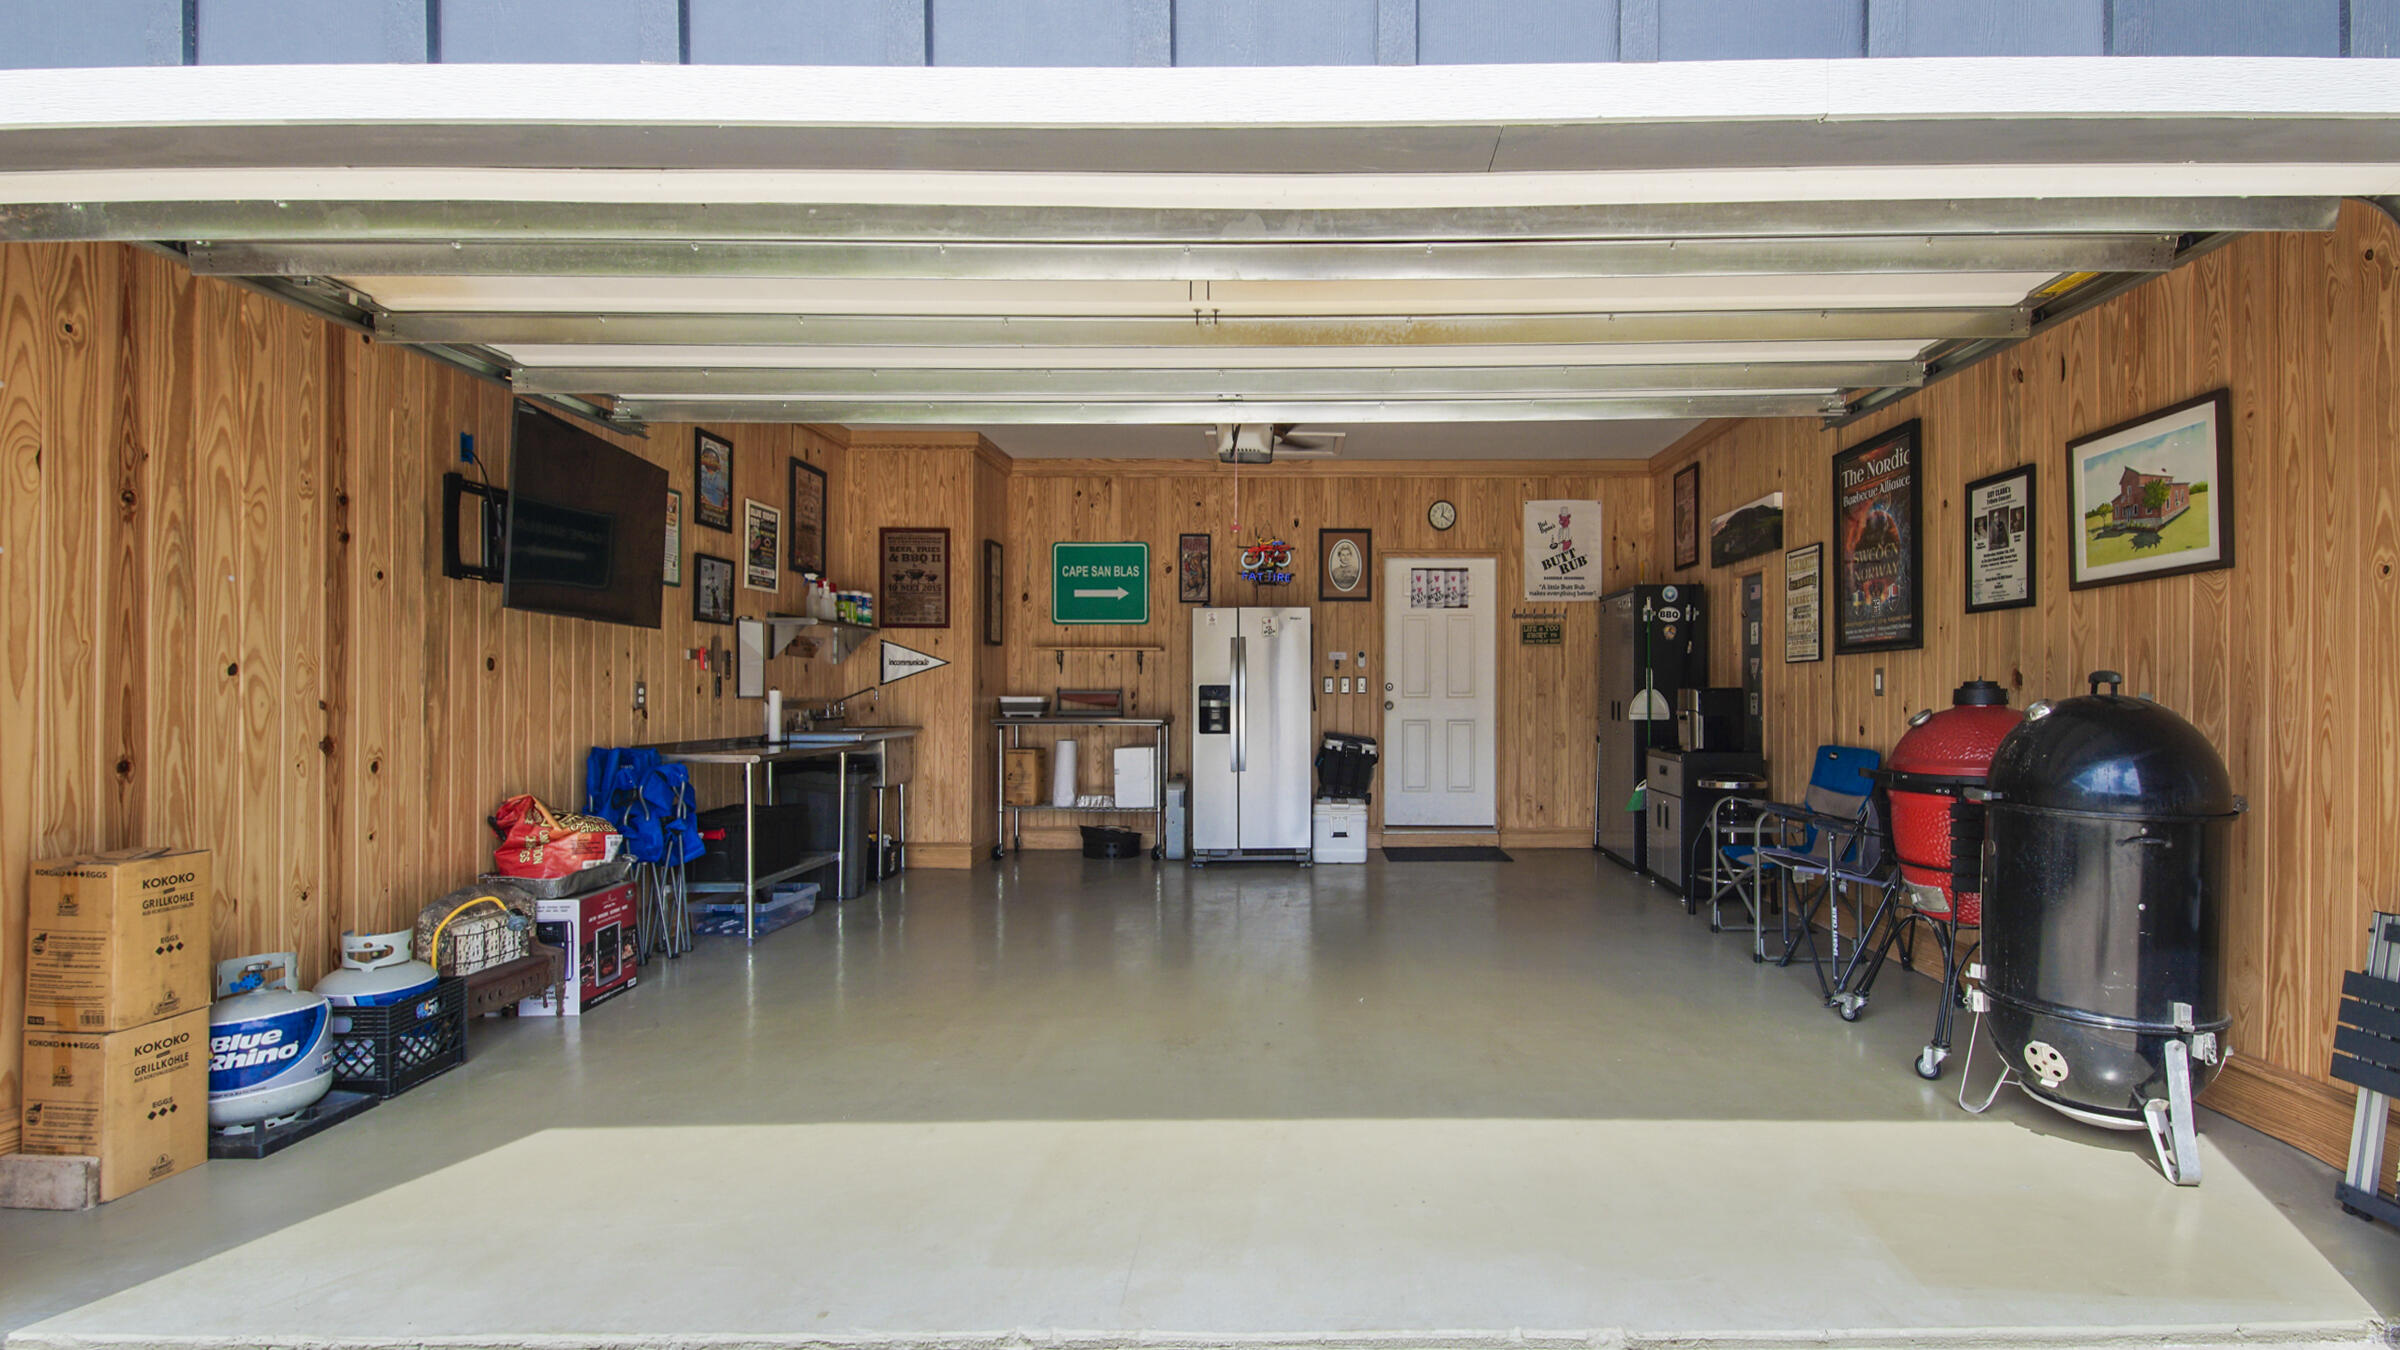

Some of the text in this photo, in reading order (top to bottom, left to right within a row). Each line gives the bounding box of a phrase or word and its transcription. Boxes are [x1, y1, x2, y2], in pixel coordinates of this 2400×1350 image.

[1841, 448, 1911, 489] The Nordic
[1843, 474, 1911, 509] Barbecue Alliance
[889, 553, 899, 562] &
[901, 553, 928, 564] BBQ
[1541, 548, 1577, 571] BUTT
[1853, 542, 1899, 564] SWEDEN
[1062, 565, 1140, 577] CAPE SAN BLAS
[1559, 555, 1588, 575] RUB
[1854, 562, 1900, 582] NORWAY
[1241, 570, 1291, 583] FAT TIRE
[1659, 610, 1679, 619] BBQ
[86, 871, 107, 879] EGGS
[142, 872, 195, 889] KOKOKO
[142, 891, 195, 910] GRILLKOHLE
[160, 934, 179, 944] EGGS
[28, 1039, 100, 1050] KOKOKO EGGS
[134, 1032, 190, 1057] KOKOKO
[210, 1028, 283, 1053] Blue
[134, 1051, 190, 1077] GRILLKOHLE
[209, 1043, 298, 1072] Rhino
[152, 1096, 174, 1108] EGGS
